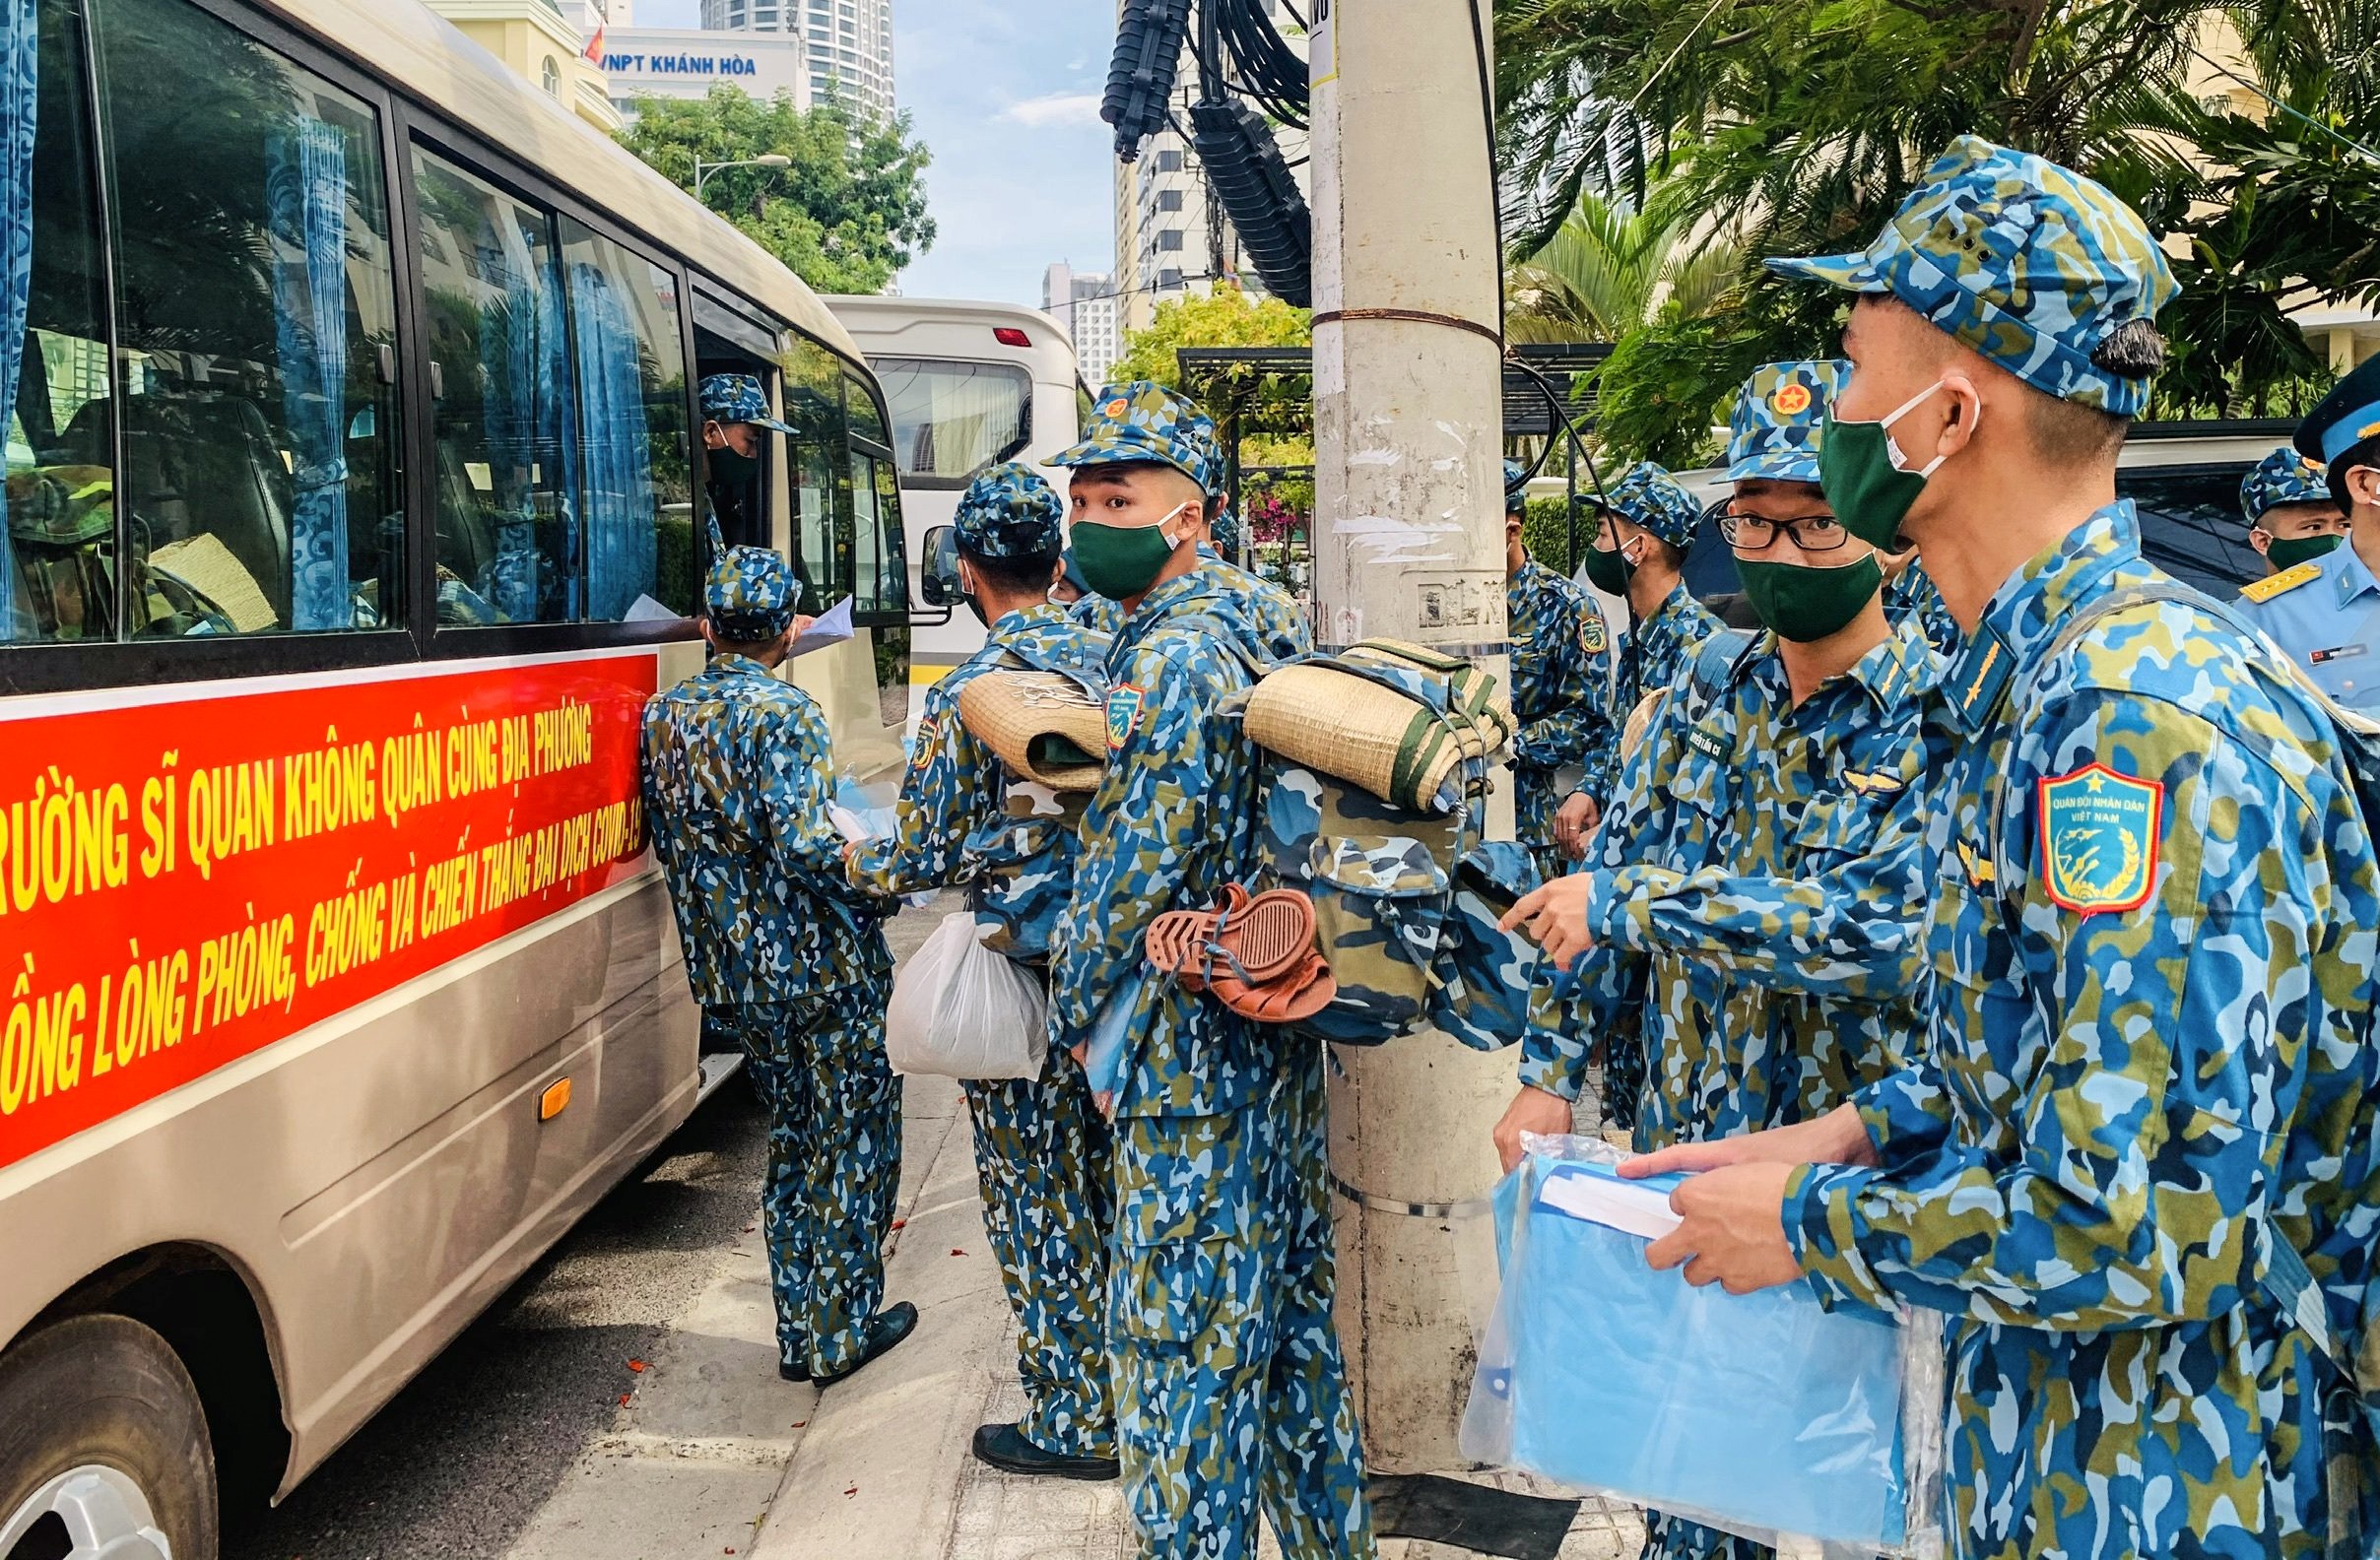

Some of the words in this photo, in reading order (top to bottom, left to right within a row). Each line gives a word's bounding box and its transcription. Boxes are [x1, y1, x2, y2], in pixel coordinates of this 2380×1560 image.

[650, 52, 714, 75] KHÁNH
[719, 54, 757, 76] HÒA
[140, 748, 179, 878] SĨ
[187, 757, 275, 881] QUAN
[284, 724, 376, 842] KHÔNG
[381, 711, 441, 829] QUÂN
[446, 704, 497, 800] CÙNG
[500, 712, 530, 799] ĐỊA
[534, 695, 592, 776] PHƯƠNG
[2053, 797, 2076, 810] QUÂN
[2093, 796, 2121, 809] NHÂN
[2123, 800, 2146, 812] DÂN
[2071, 811, 2091, 822] VIỆT
[2094, 812, 2120, 823] NAM
[0, 951, 87, 1116] ỒNG
[92, 937, 189, 1077] LÒNG
[192, 901, 298, 1036] PHÒNG,
[304, 857, 387, 989] CHỐNG
[389, 851, 417, 953] VÀ
[421, 824, 479, 940] CHIẾN
[481, 808, 533, 915] THẮNG
[532, 823, 560, 901] ĐẠI
[560, 810, 592, 892] DỊCH
[592, 795, 642, 868] COVID-19
